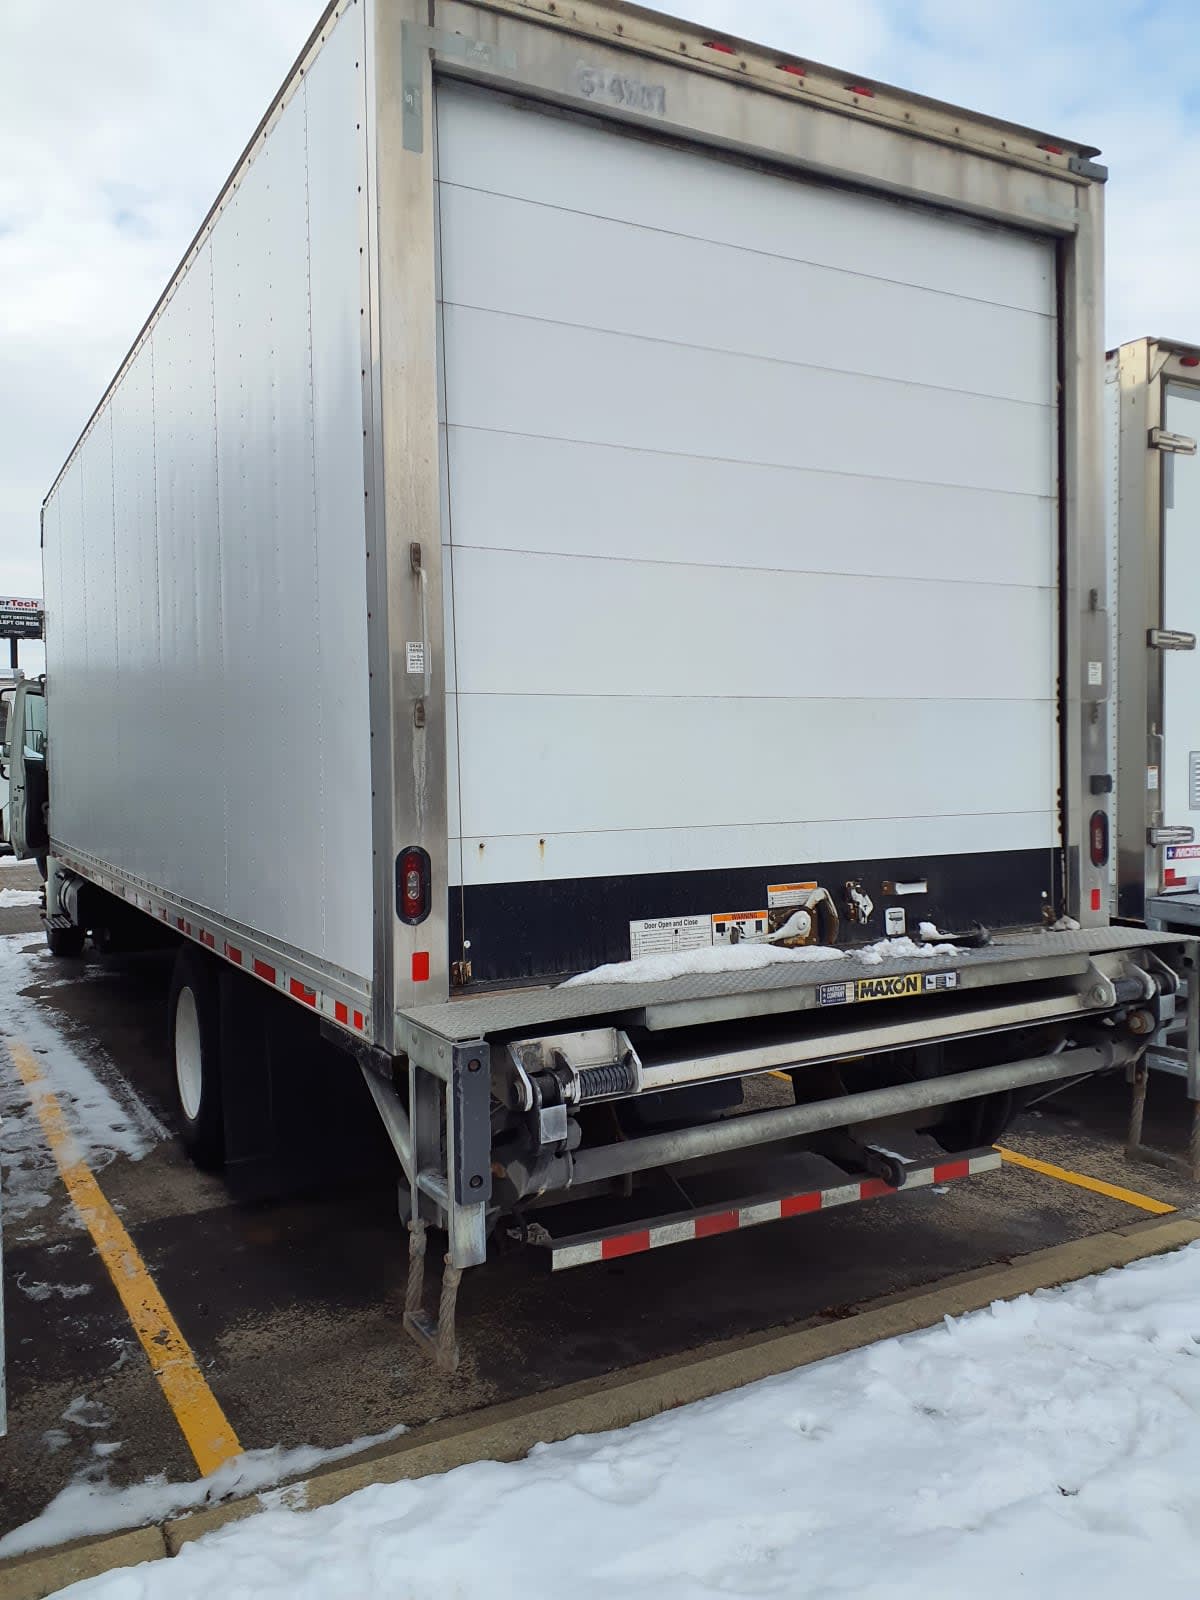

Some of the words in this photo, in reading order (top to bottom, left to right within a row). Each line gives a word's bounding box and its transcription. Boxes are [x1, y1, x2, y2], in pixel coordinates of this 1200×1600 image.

[731, 912, 758, 921] WARNING
[643, 922, 657, 930] Door
[658, 921, 672, 929] Open
[860, 976, 918, 998] MAXON
